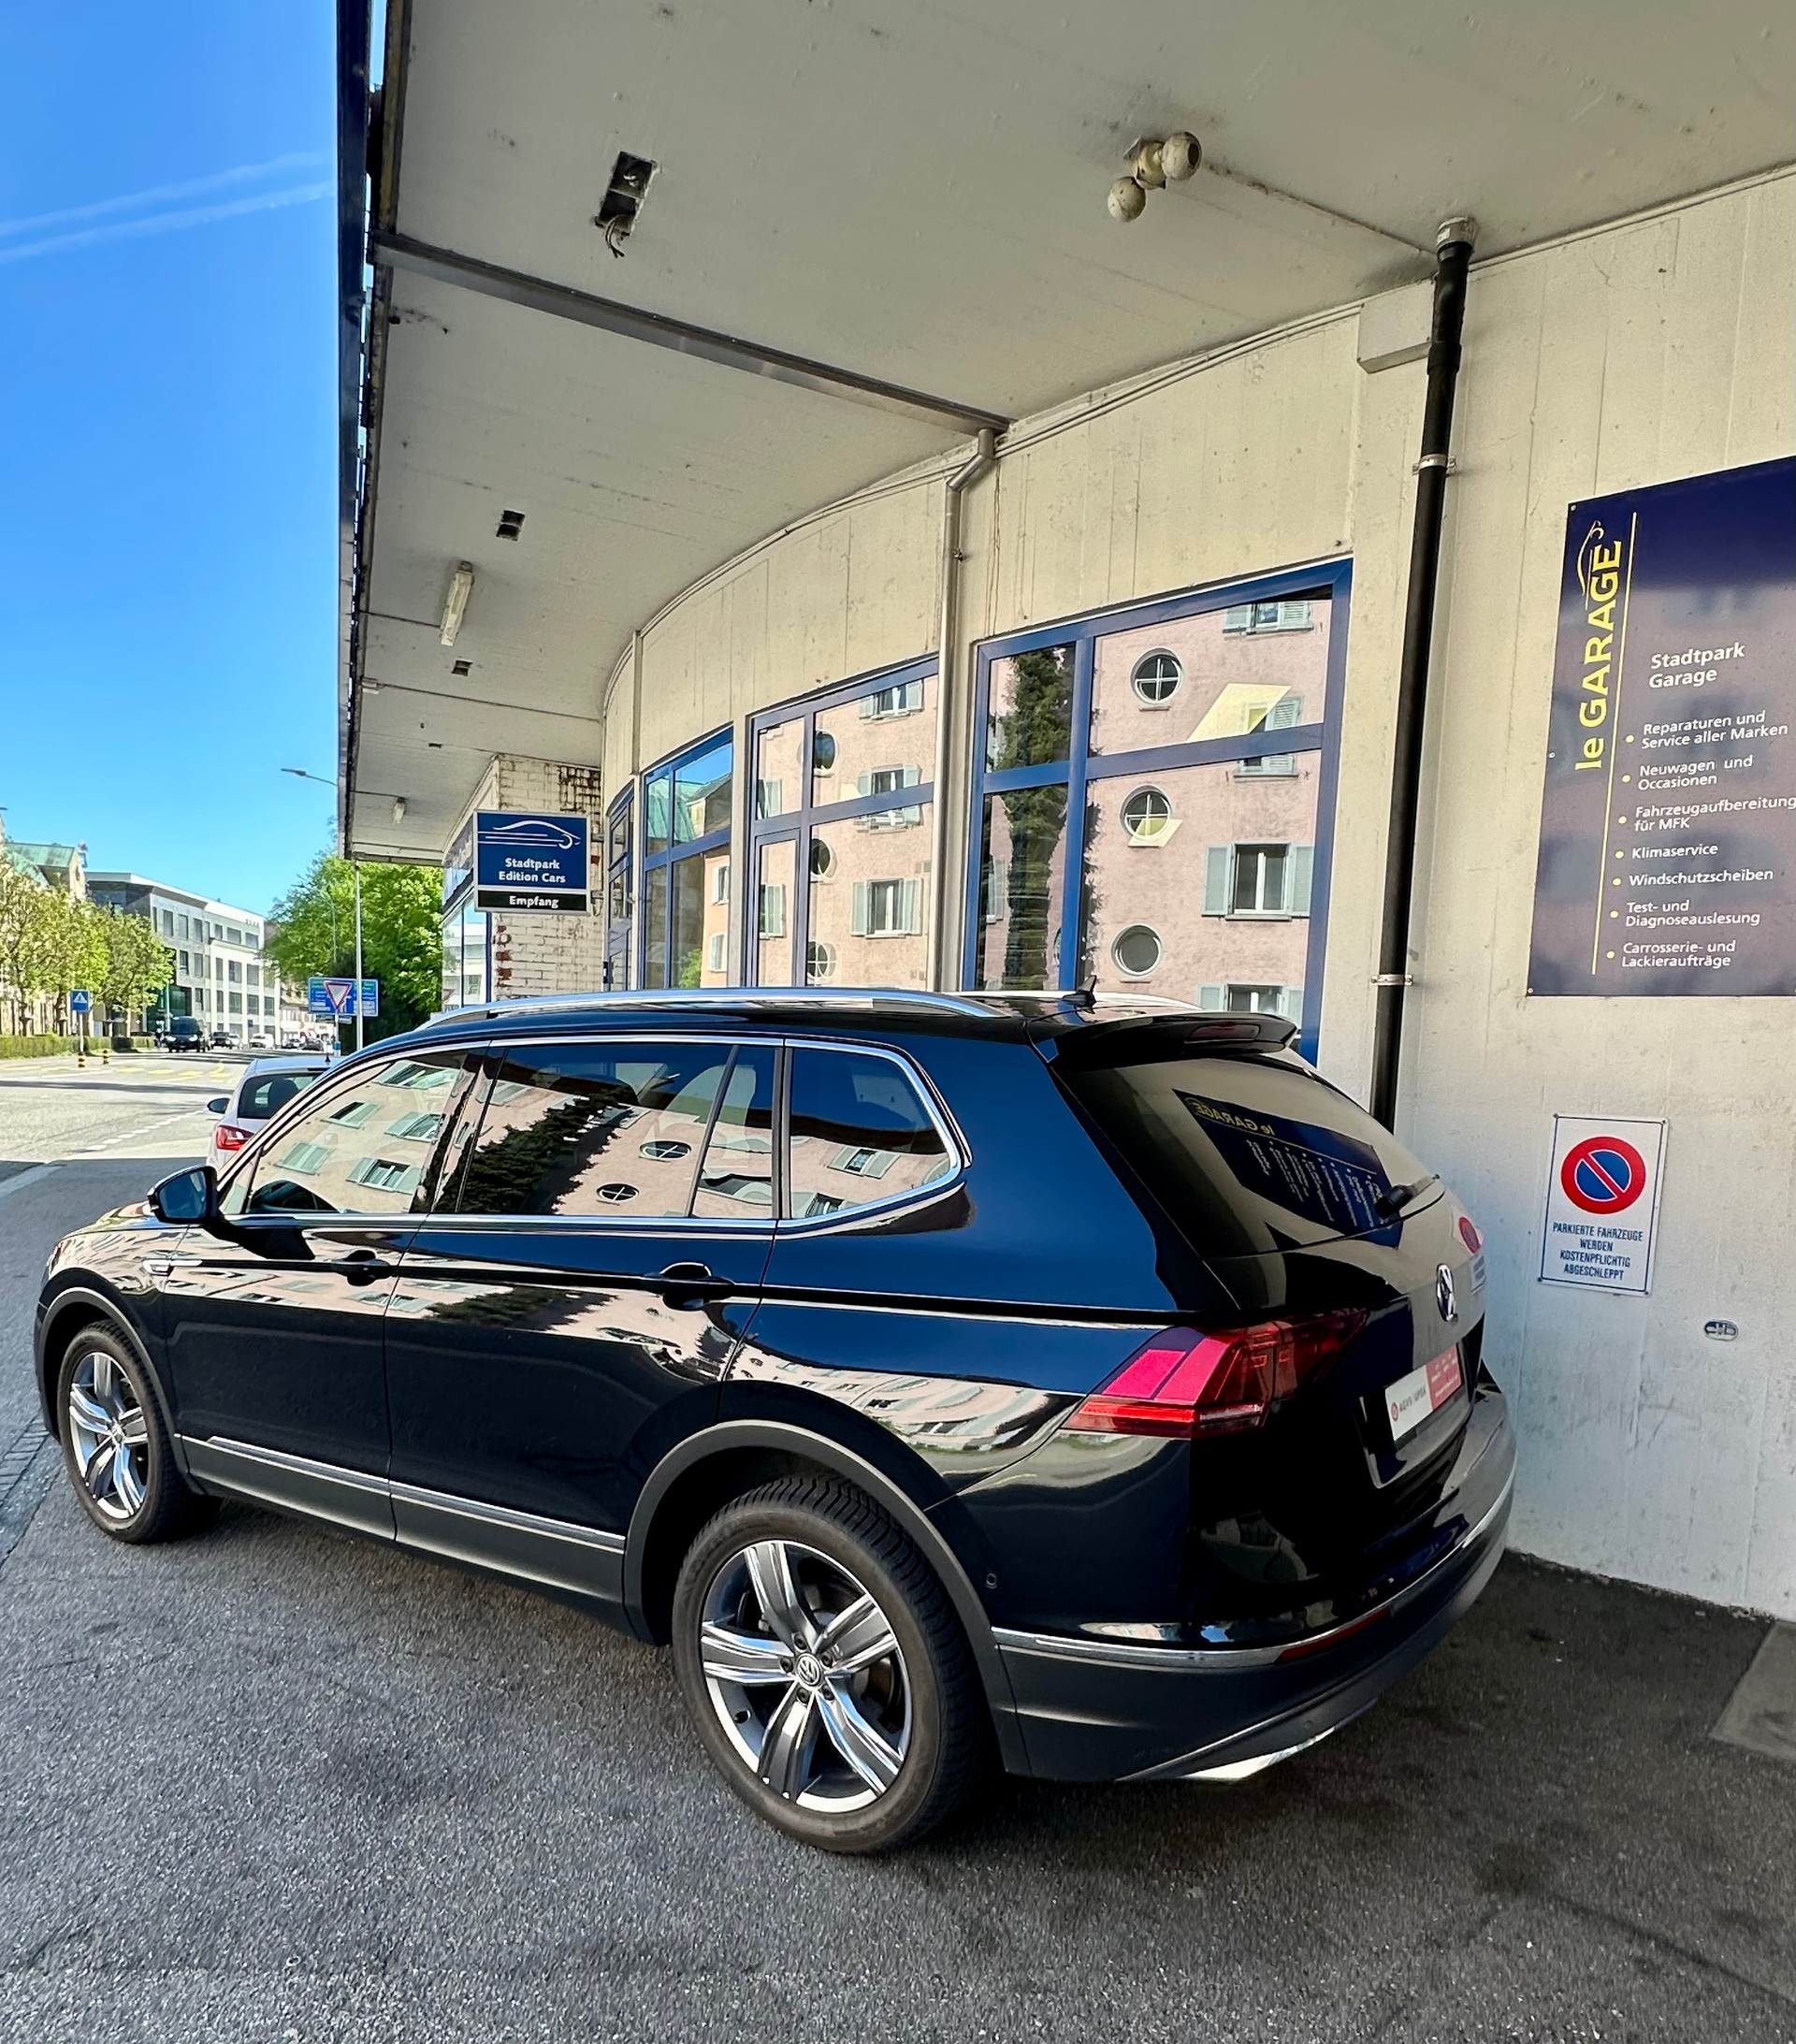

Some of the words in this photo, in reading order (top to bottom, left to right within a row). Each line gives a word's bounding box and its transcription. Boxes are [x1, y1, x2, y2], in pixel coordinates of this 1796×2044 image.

[1579, 540, 1622, 728] GARAGE
[1650, 642, 1745, 670] Stadtpark
[1648, 669, 1717, 689] Garage
[1643, 717, 1731, 736] Reparaturen
[1736, 710, 1766, 725] und
[1642, 734, 1690, 749] Service
[1694, 731, 1727, 744] aller
[1731, 725, 1789, 740] Marken
[1575, 737, 1604, 770] le
[1640, 761, 1716, 776] Neuwagen
[1724, 754, 1754, 769] und
[1638, 775, 1717, 790] Occasionen
[1635, 796, 1796, 819] Fahrzeugaufbereitung
[1634, 819, 1655, 832] für
[1658, 817, 1690, 831] MFK
[1631, 843, 1719, 859] Klimaservice
[505, 857, 560, 871] Stadtpark
[499, 871, 539, 882] Edition
[542, 873, 566, 883] Cars
[1629, 869, 1774, 886] Windschutzscheiben
[509, 895, 559, 909] Empfang
[1626, 901, 1658, 913] Test-
[1662, 899, 1690, 912] und
[1625, 912, 1760, 929] Diagnoseauslesung
[1623, 941, 1703, 954] Carrosserie-
[1707, 939, 1736, 952] und
[1622, 954, 1731, 969] Lackieraufträge
[1553, 1222, 1595, 1237] PARKIERTE
[1597, 1226, 1644, 1242] FAHRZEUGE
[1580, 1238, 1614, 1252] WERDEN
[1559, 1250, 1631, 1268] KOSTENPFLICHTIG
[1564, 1263, 1625, 1281] ABGESCHLEPPT
